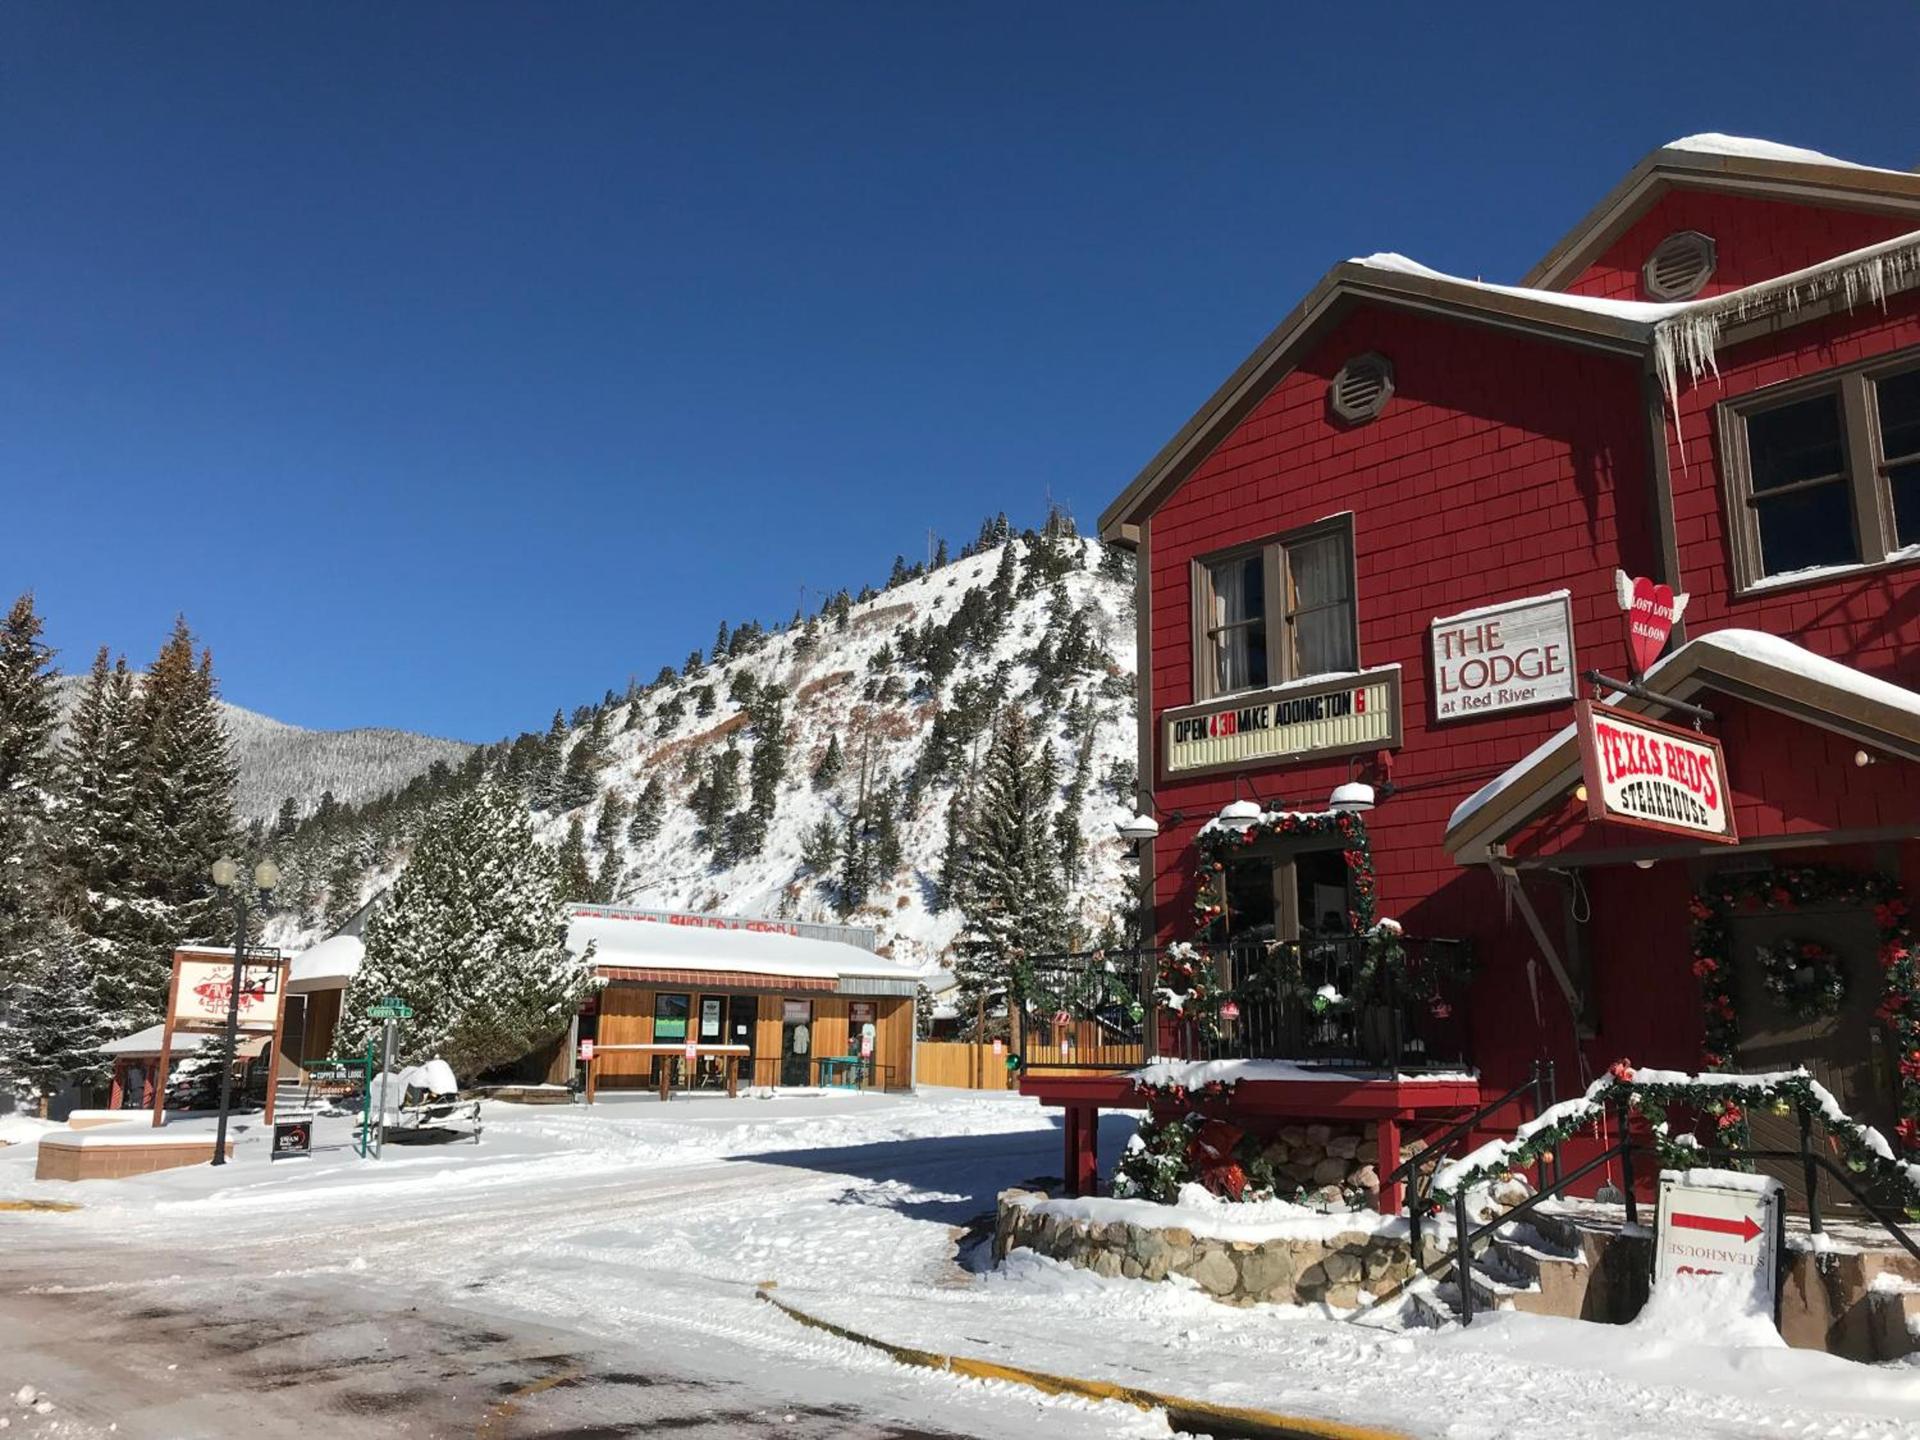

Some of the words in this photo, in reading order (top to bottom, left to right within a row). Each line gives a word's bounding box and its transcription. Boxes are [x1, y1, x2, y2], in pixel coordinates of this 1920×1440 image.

[1632, 597, 1652, 613] LOST
[1653, 604, 1674, 621] LOVE
[1438, 622, 1504, 660] THE
[1632, 622, 1665, 640] SALOON
[1440, 645, 1565, 694] LODGE
[1175, 716, 1208, 743] OPEN
[1238, 706, 1269, 733] MIKE
[1274, 691, 1351, 727] ADDINGTON
[1355, 688, 1366, 714] 6
[1441, 701, 1456, 713] at
[1462, 692, 1492, 710] Red
[1498, 687, 1537, 705] River
[1596, 722, 1663, 784] TEXAS
[1664, 742, 1717, 810] REDS
[1620, 780, 1709, 826] STEAKHOUSE
